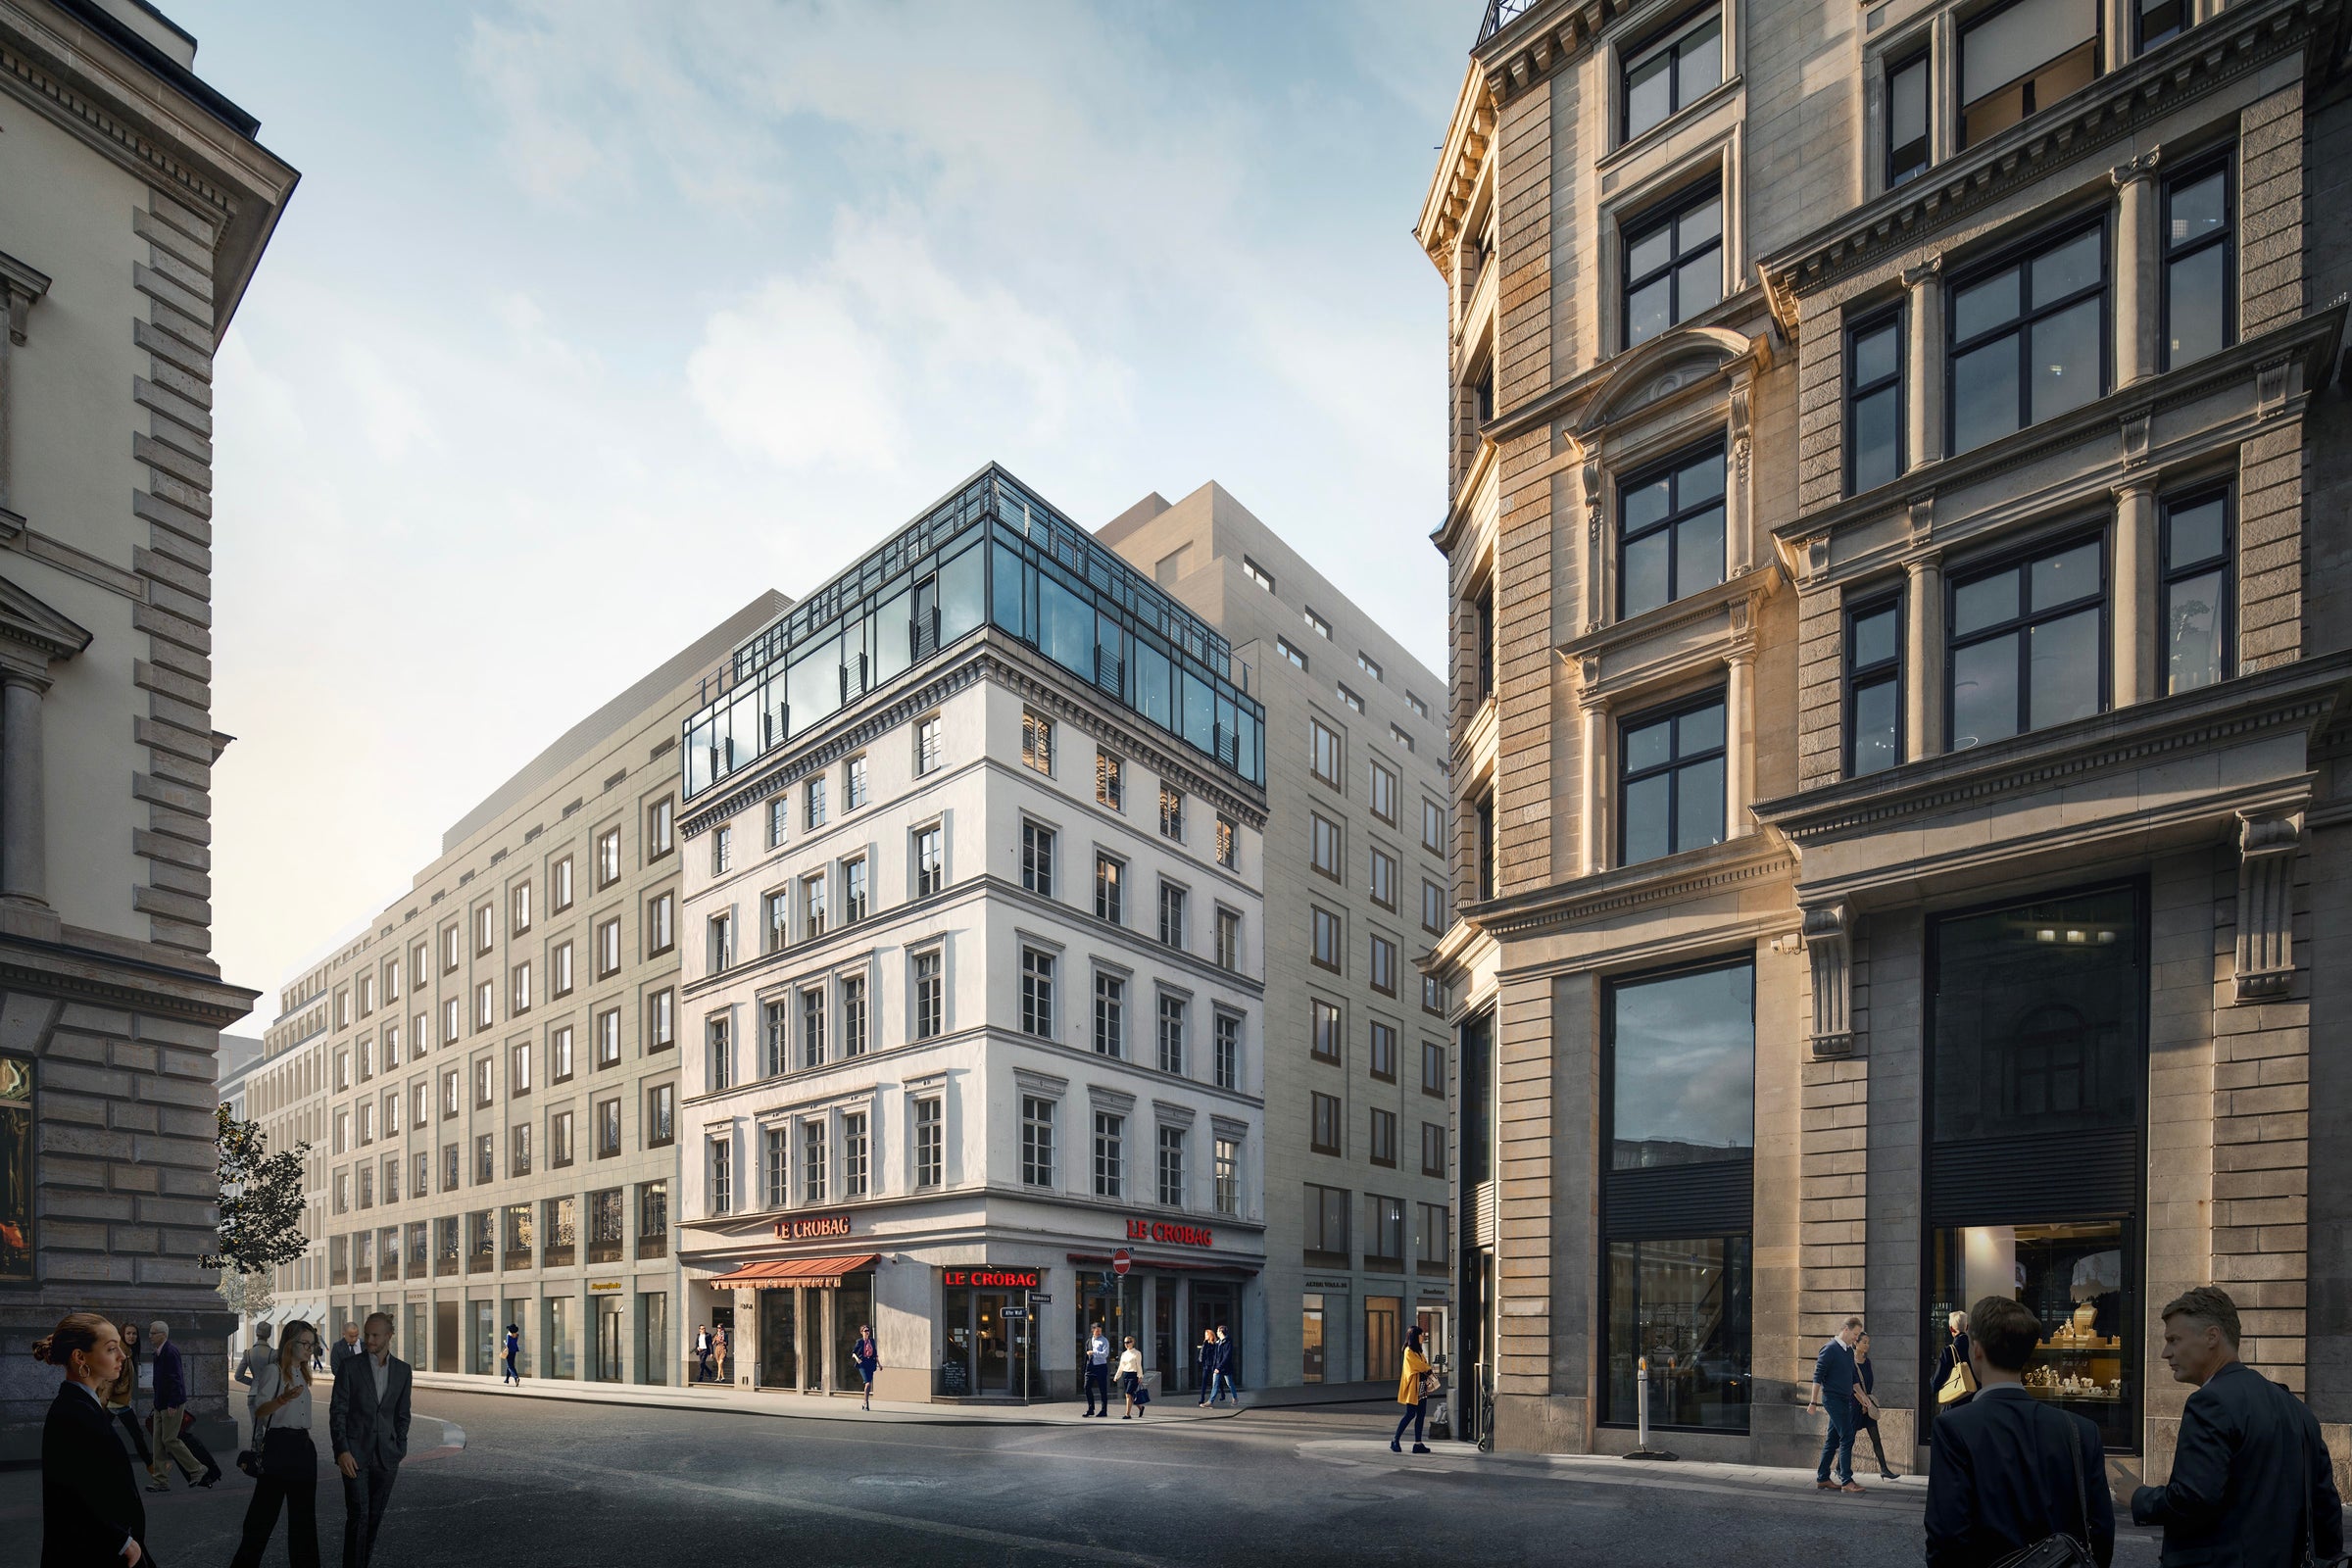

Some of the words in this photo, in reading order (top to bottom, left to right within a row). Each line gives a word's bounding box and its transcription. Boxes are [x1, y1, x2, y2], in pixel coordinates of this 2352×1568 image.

[774, 1222, 791, 1240] LE
[793, 1215, 851, 1239] CROBAG
[1126, 1219, 1149, 1240] LE
[1152, 1222, 1213, 1247] CROBAG
[945, 1272, 965, 1286] LE
